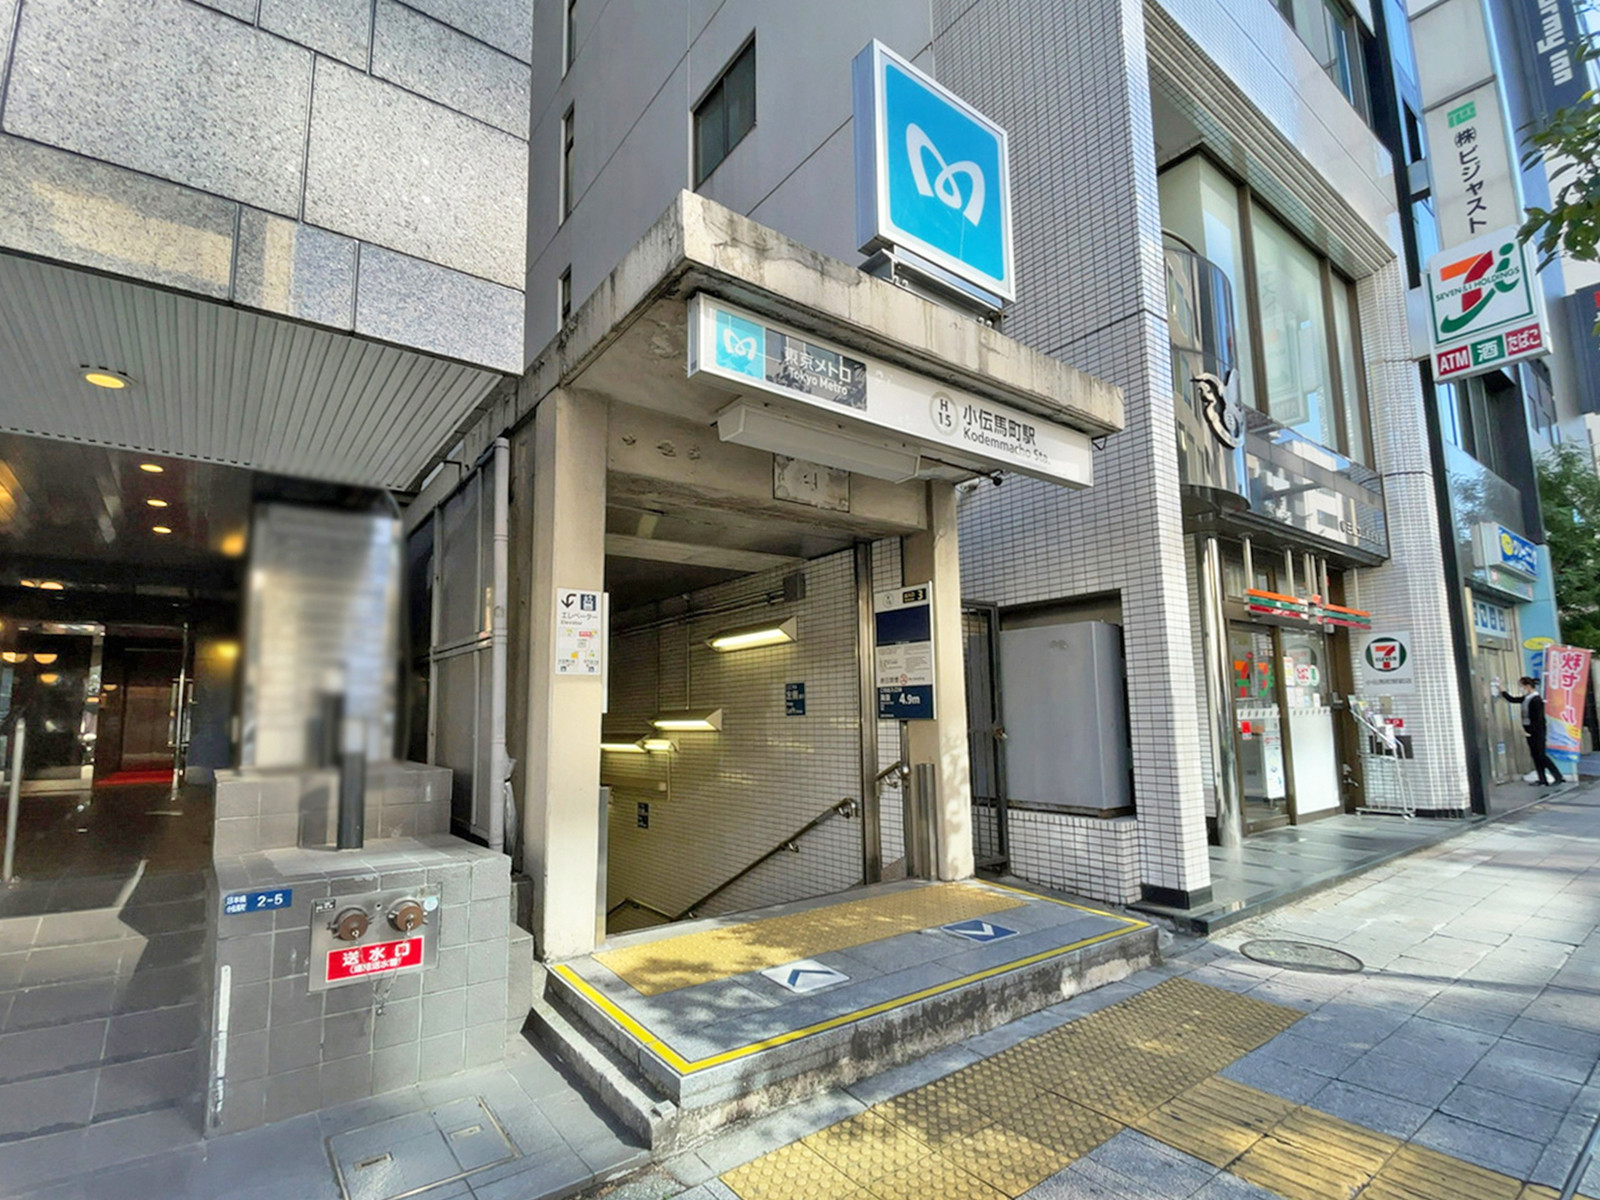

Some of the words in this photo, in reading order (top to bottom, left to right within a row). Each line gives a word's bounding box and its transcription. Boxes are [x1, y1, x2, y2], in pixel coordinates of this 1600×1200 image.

[1549, 49, 1573, 86] inn
[1474, 266, 1521, 288] HOLDINGS
[784, 346, 851, 383] 東京メトロ
[1439, 350, 1469, 373] ATM
[1476, 340, 1498, 362] 酒
[1506, 329, 1540, 352] たばこ
[788, 366, 818, 386] Tokyo
[819, 376, 848, 396] Metro
[940, 399, 948, 412] H
[938, 412, 952, 428] 15
[963, 404, 1037, 446] 小伝馬町駅
[963, 427, 1031, 458] Kodemmacho
[898, 693, 921, 705] 4.9m
[257, 893, 283, 907] 2-5
[342, 942, 410, 967] 送水口
